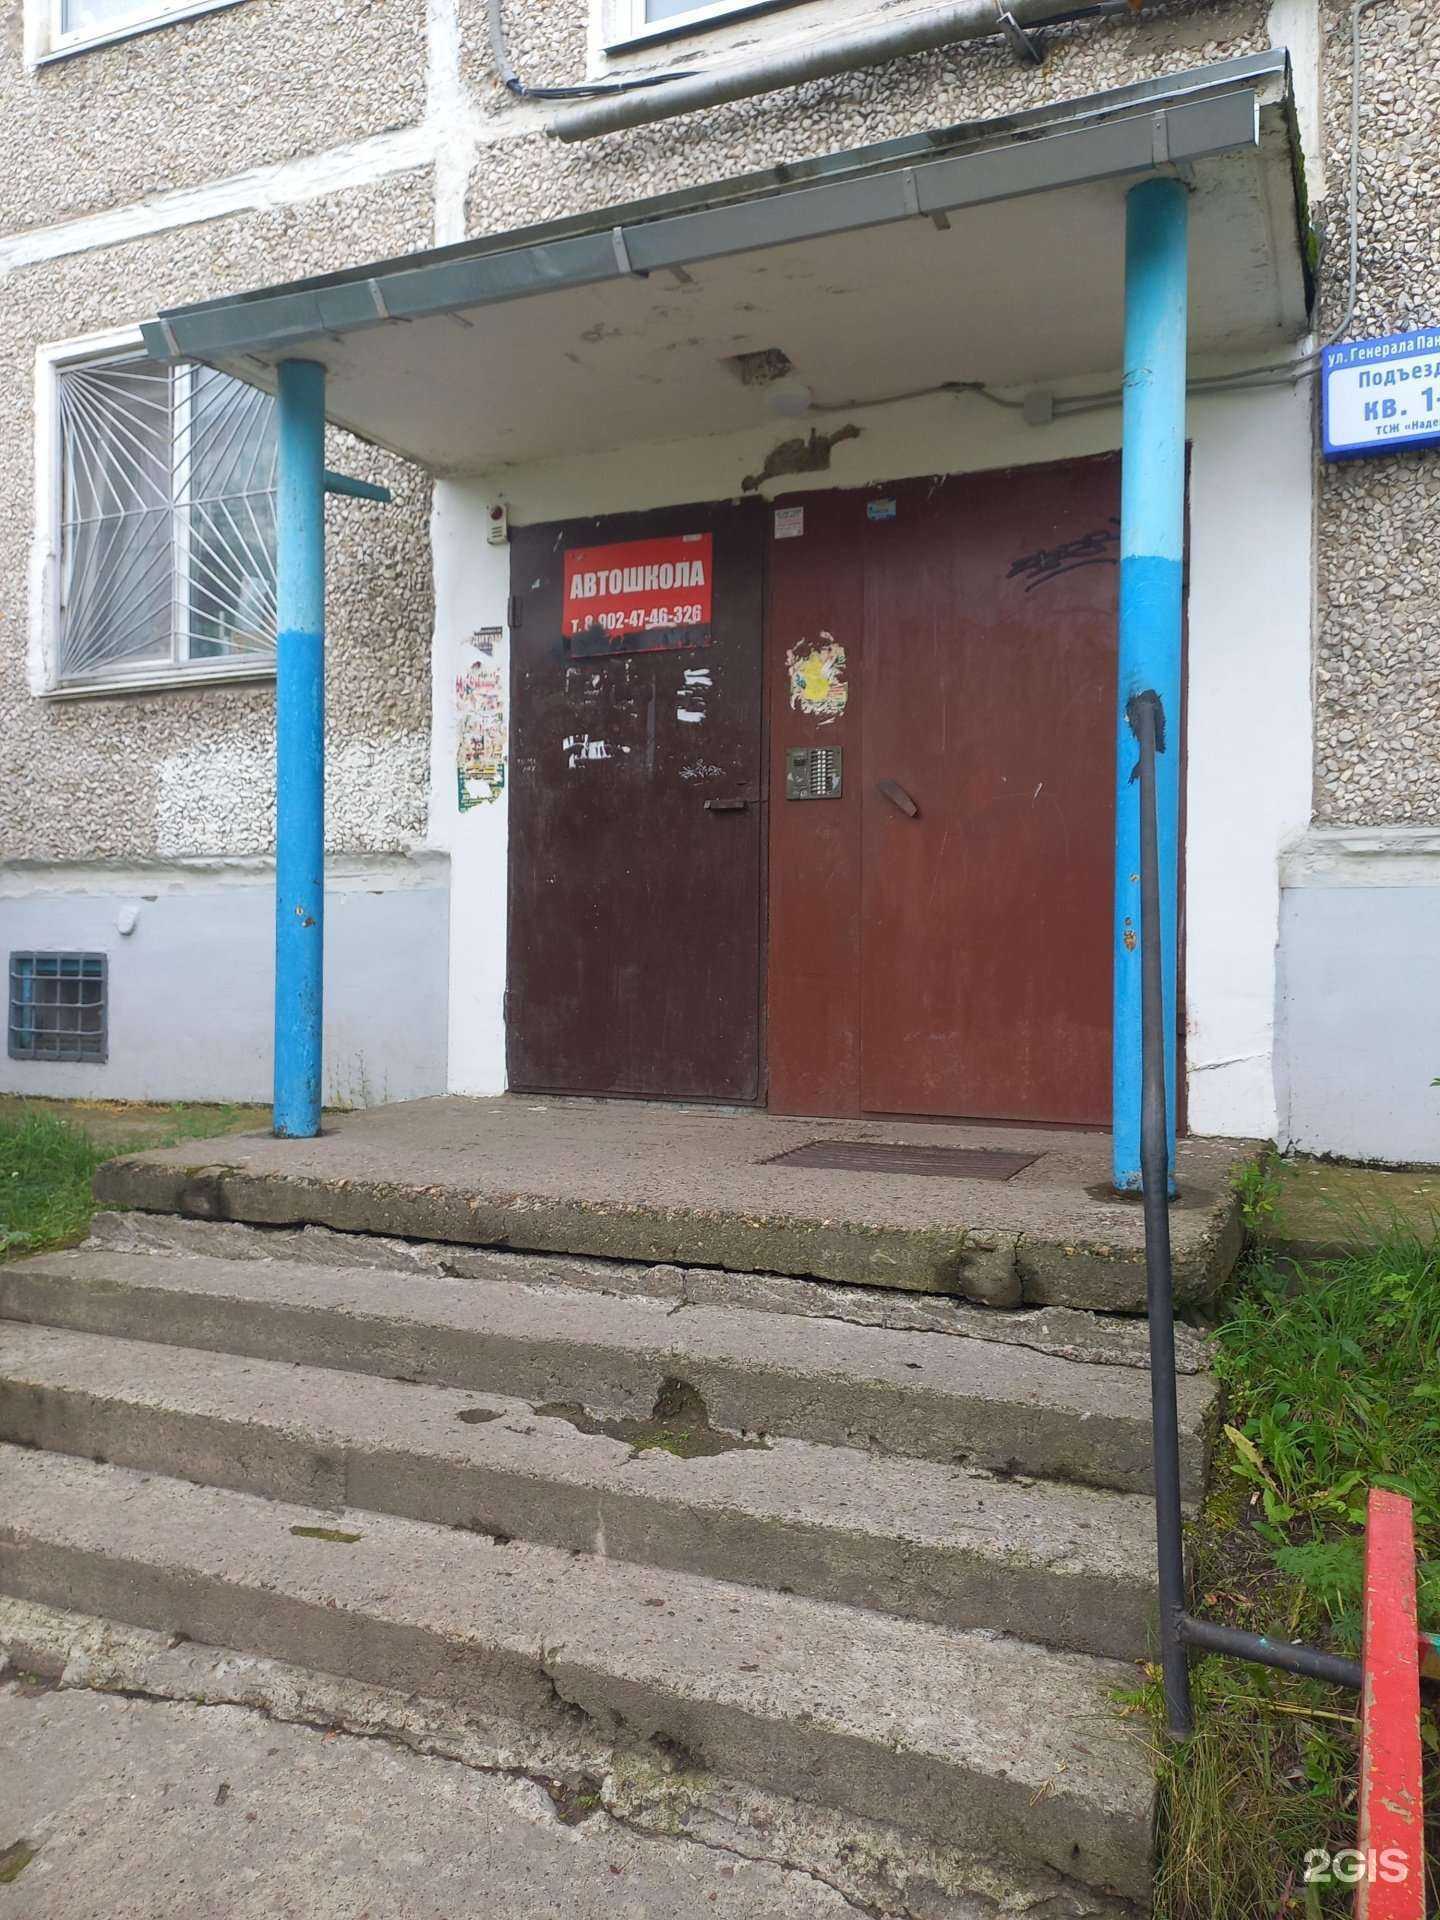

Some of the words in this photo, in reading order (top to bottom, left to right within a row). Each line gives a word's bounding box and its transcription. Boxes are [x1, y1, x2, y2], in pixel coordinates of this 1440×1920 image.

[1328, 352, 1349, 367] ул.
[1350, 340, 1414, 362] Генерала
[1364, 398, 1407, 421] кв.
[1376, 423, 1400, 435] ТСЖ
[569, 560, 705, 600] АВТОШКОЛА
